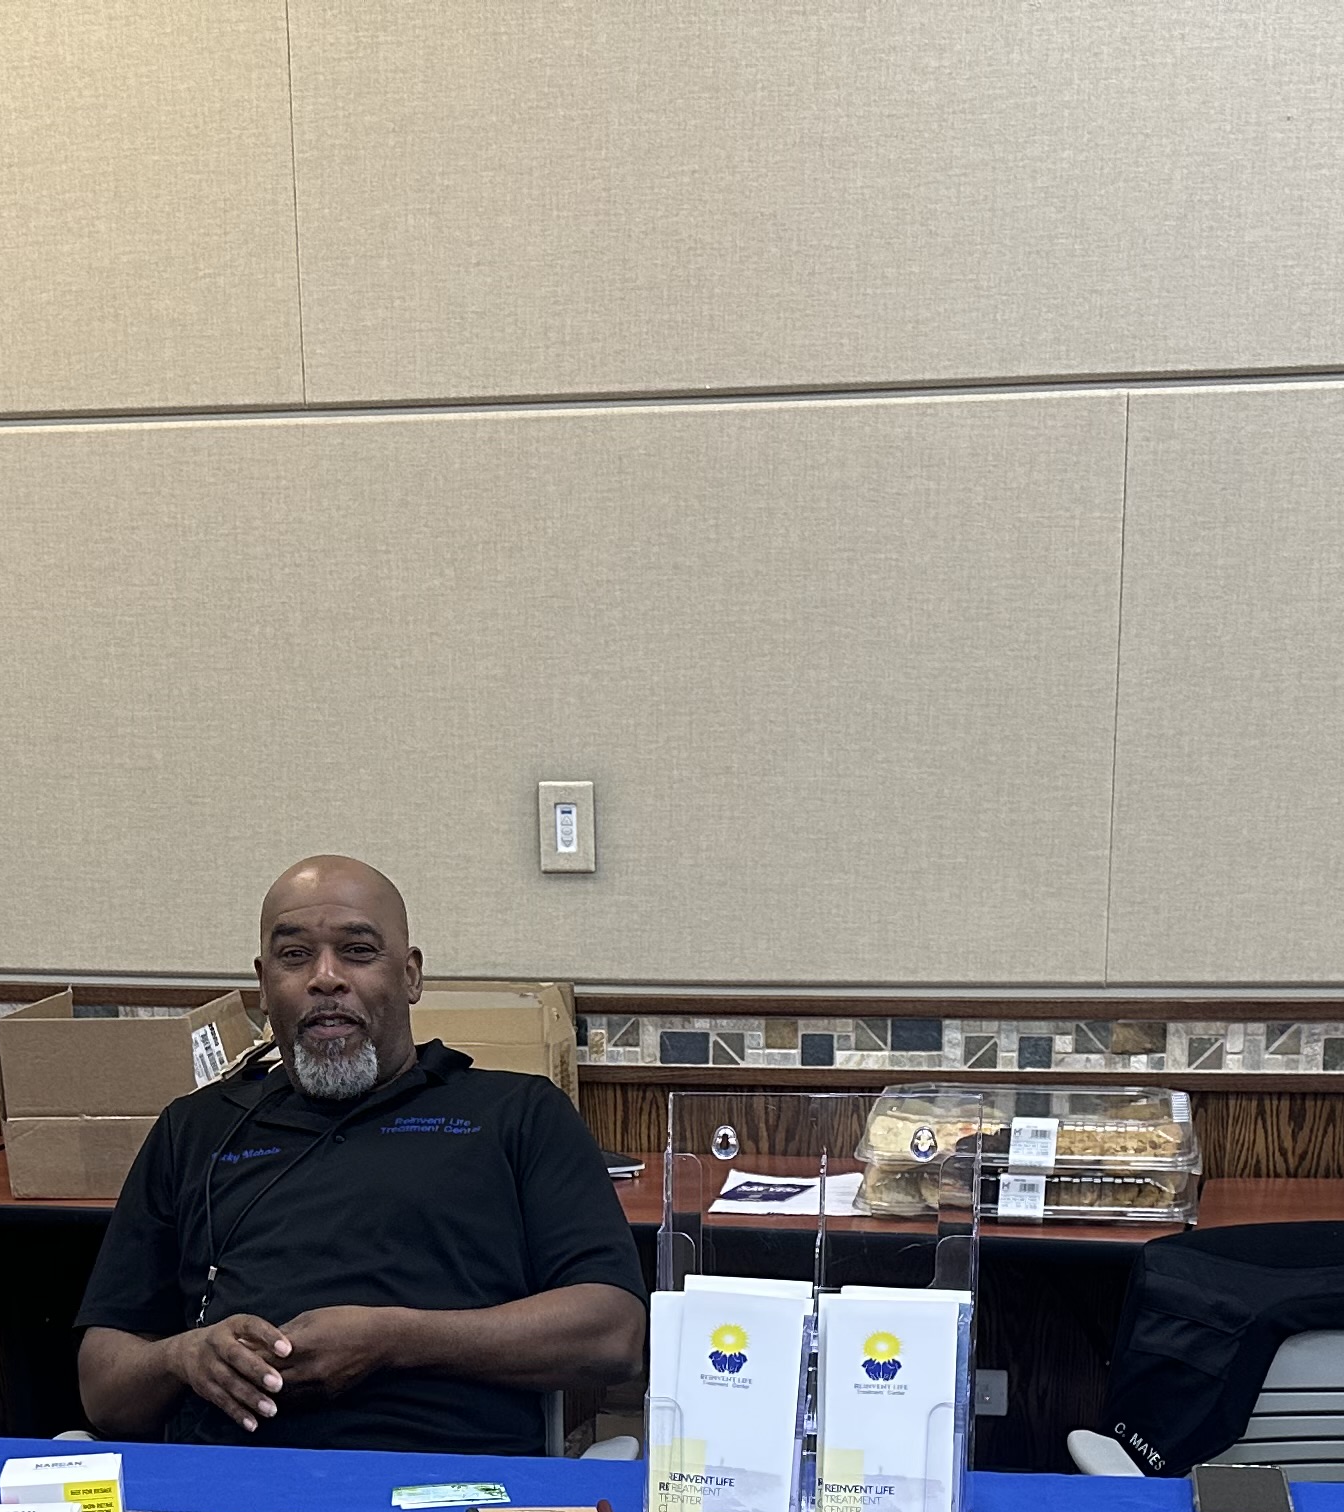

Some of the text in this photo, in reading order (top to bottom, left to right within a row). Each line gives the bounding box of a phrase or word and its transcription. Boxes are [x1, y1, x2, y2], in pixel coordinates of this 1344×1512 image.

[1114, 1422, 1166, 1470] C. MAYES
[35, 1461, 83, 1469] NARCAN
[824, 1483, 895, 1495] REINVENT LIFE
[825, 1494, 882, 1505] TREATMENT
